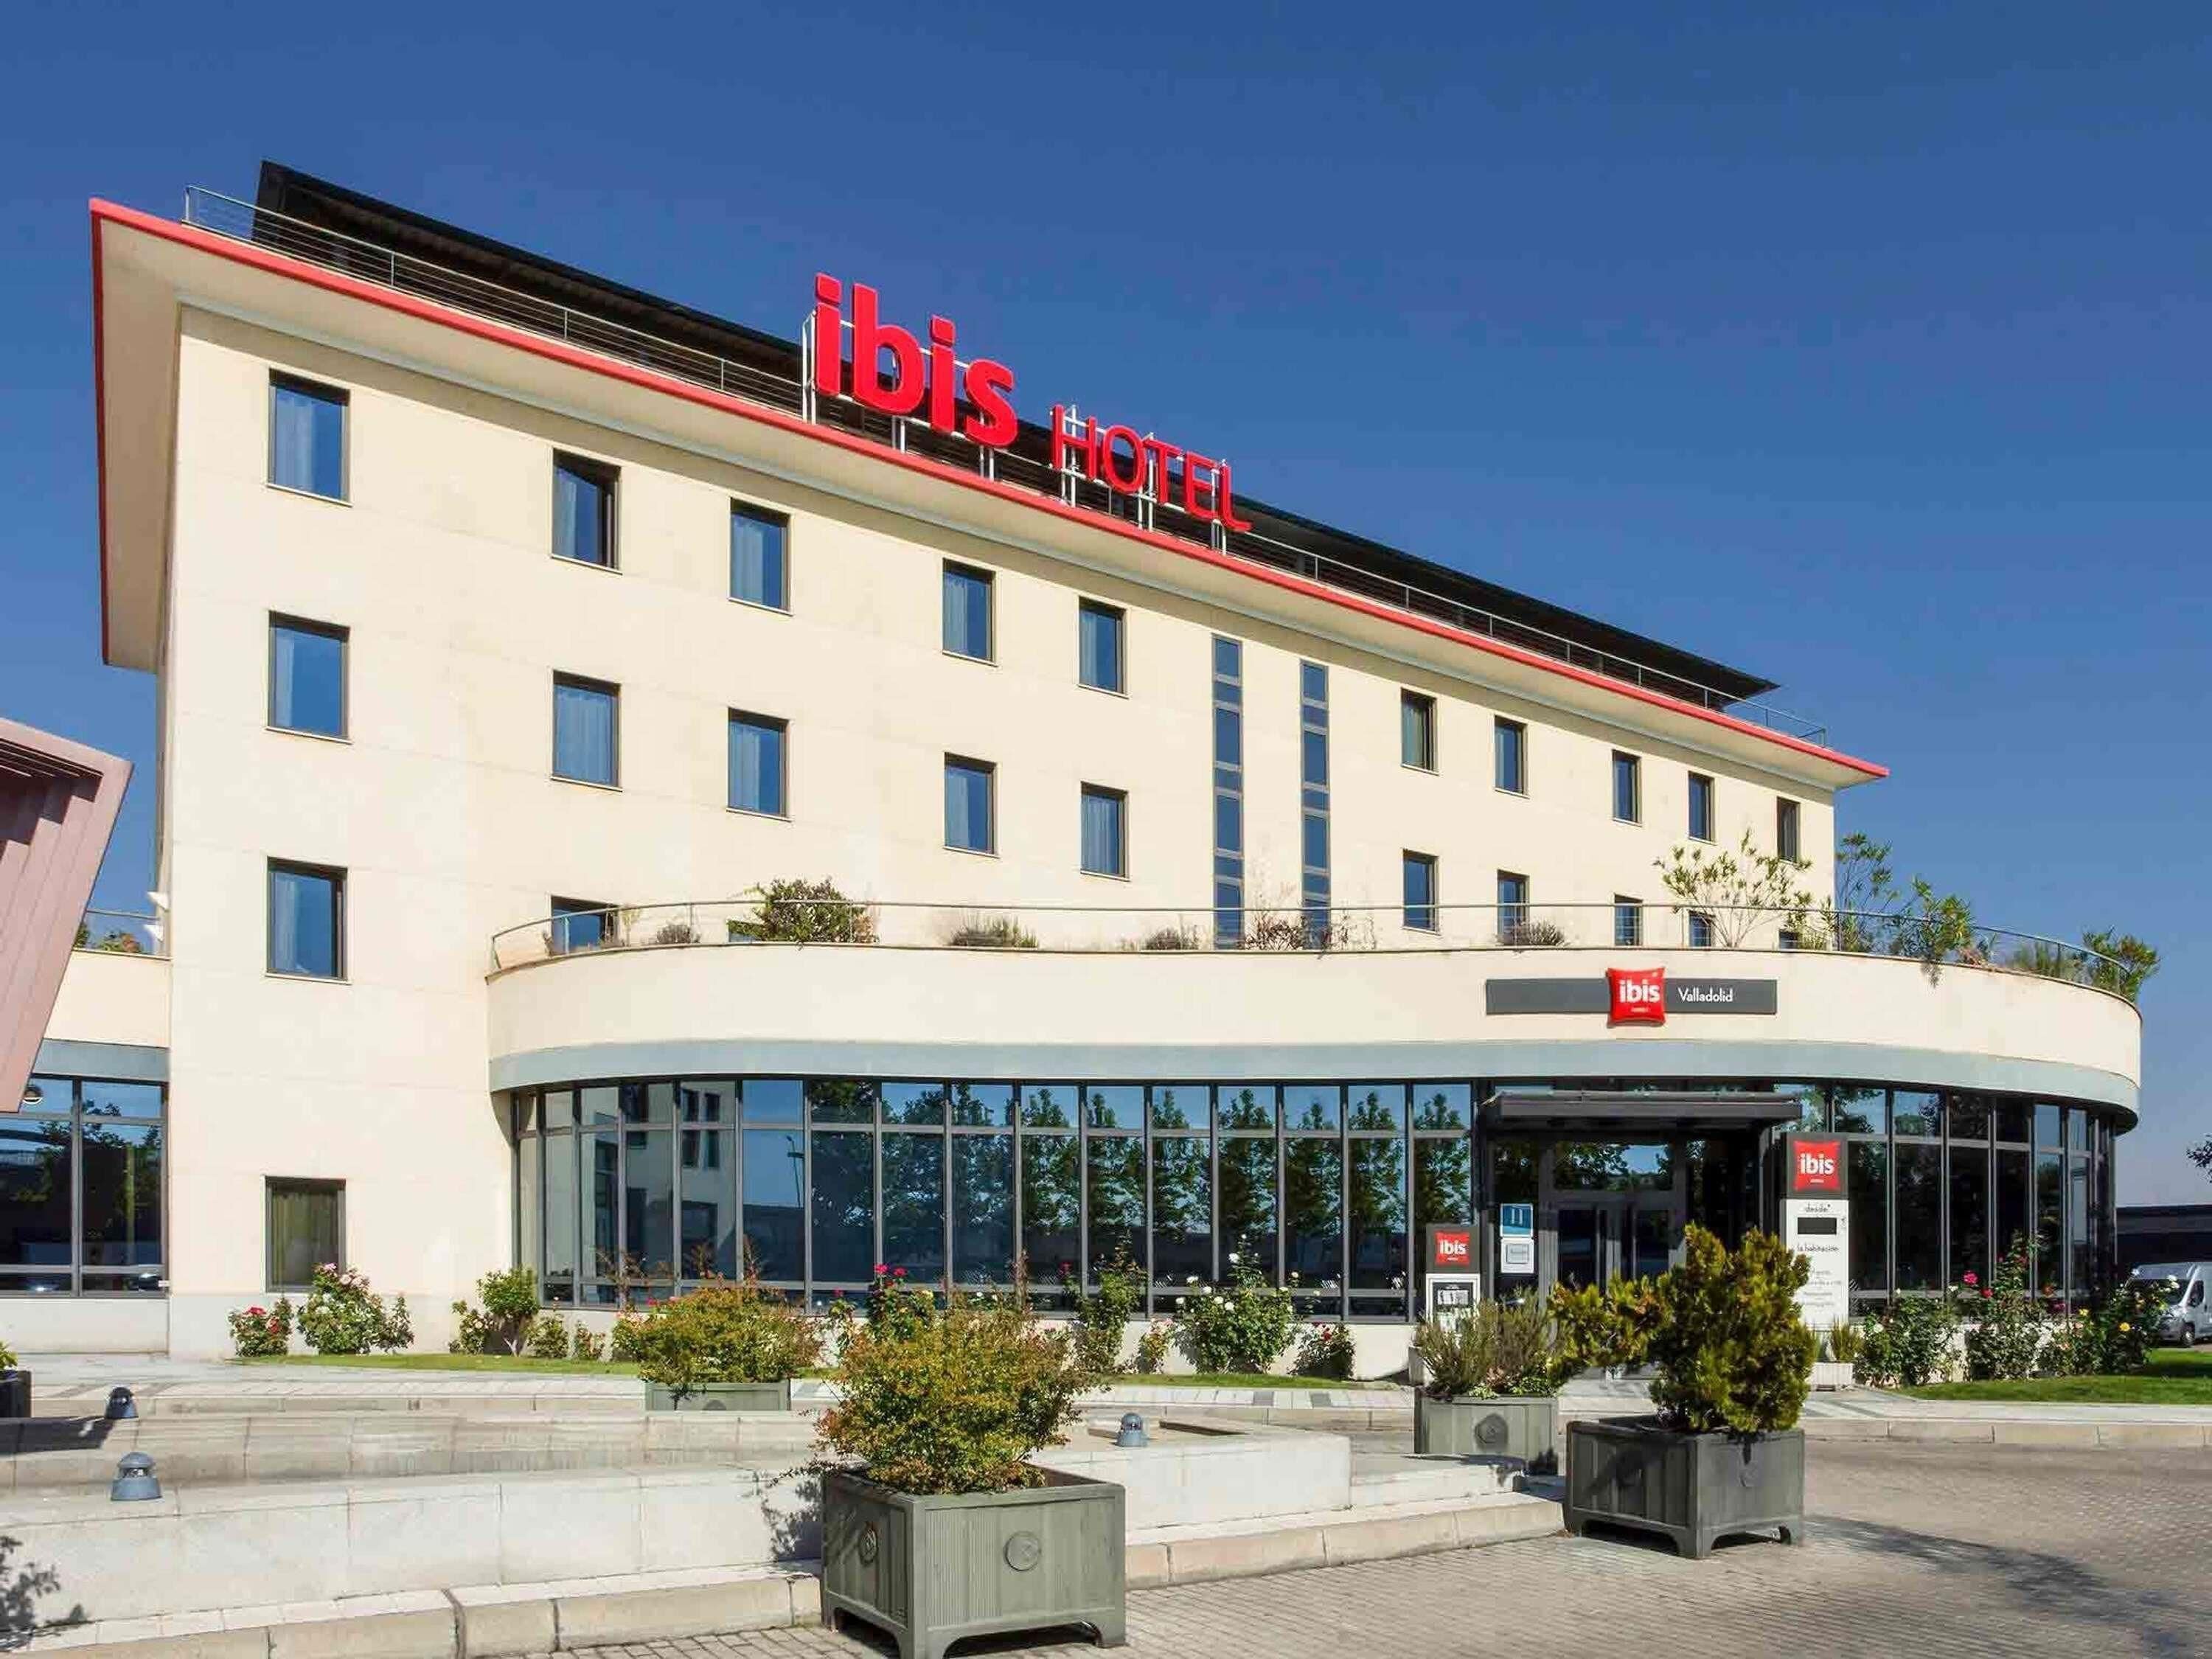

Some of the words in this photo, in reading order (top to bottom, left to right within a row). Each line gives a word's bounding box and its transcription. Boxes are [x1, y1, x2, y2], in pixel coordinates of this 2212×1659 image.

[816, 272, 1018, 448] ibis
[1050, 405, 1251, 532] HOTEL
[1619, 979, 1660, 1004] ibis
[1677, 987, 1733, 1003] Valladolid
[1799, 1152, 1835, 1175] ibis
[1439, 1239, 1467, 1255] ibis
